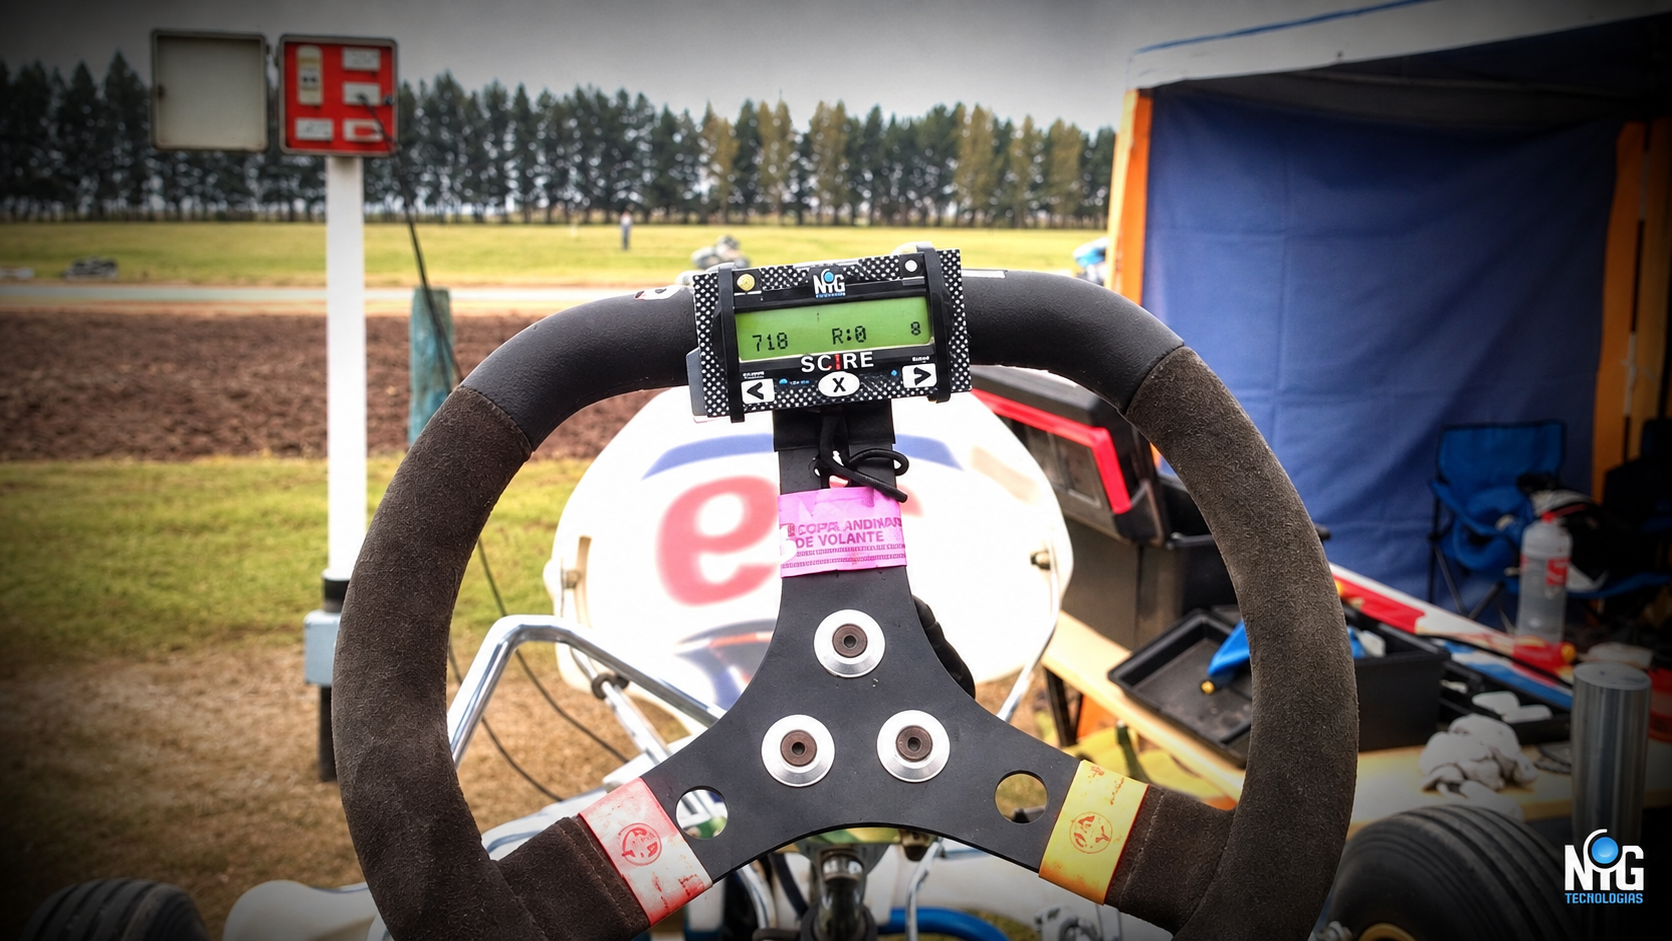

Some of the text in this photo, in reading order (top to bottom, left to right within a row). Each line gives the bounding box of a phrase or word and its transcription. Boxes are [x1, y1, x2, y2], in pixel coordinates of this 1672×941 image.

[752, 332, 788, 351] 718
[910, 321, 922, 336] 8
[832, 376, 847, 392] X
[795, 530, 885, 549] DE VOLANTE
